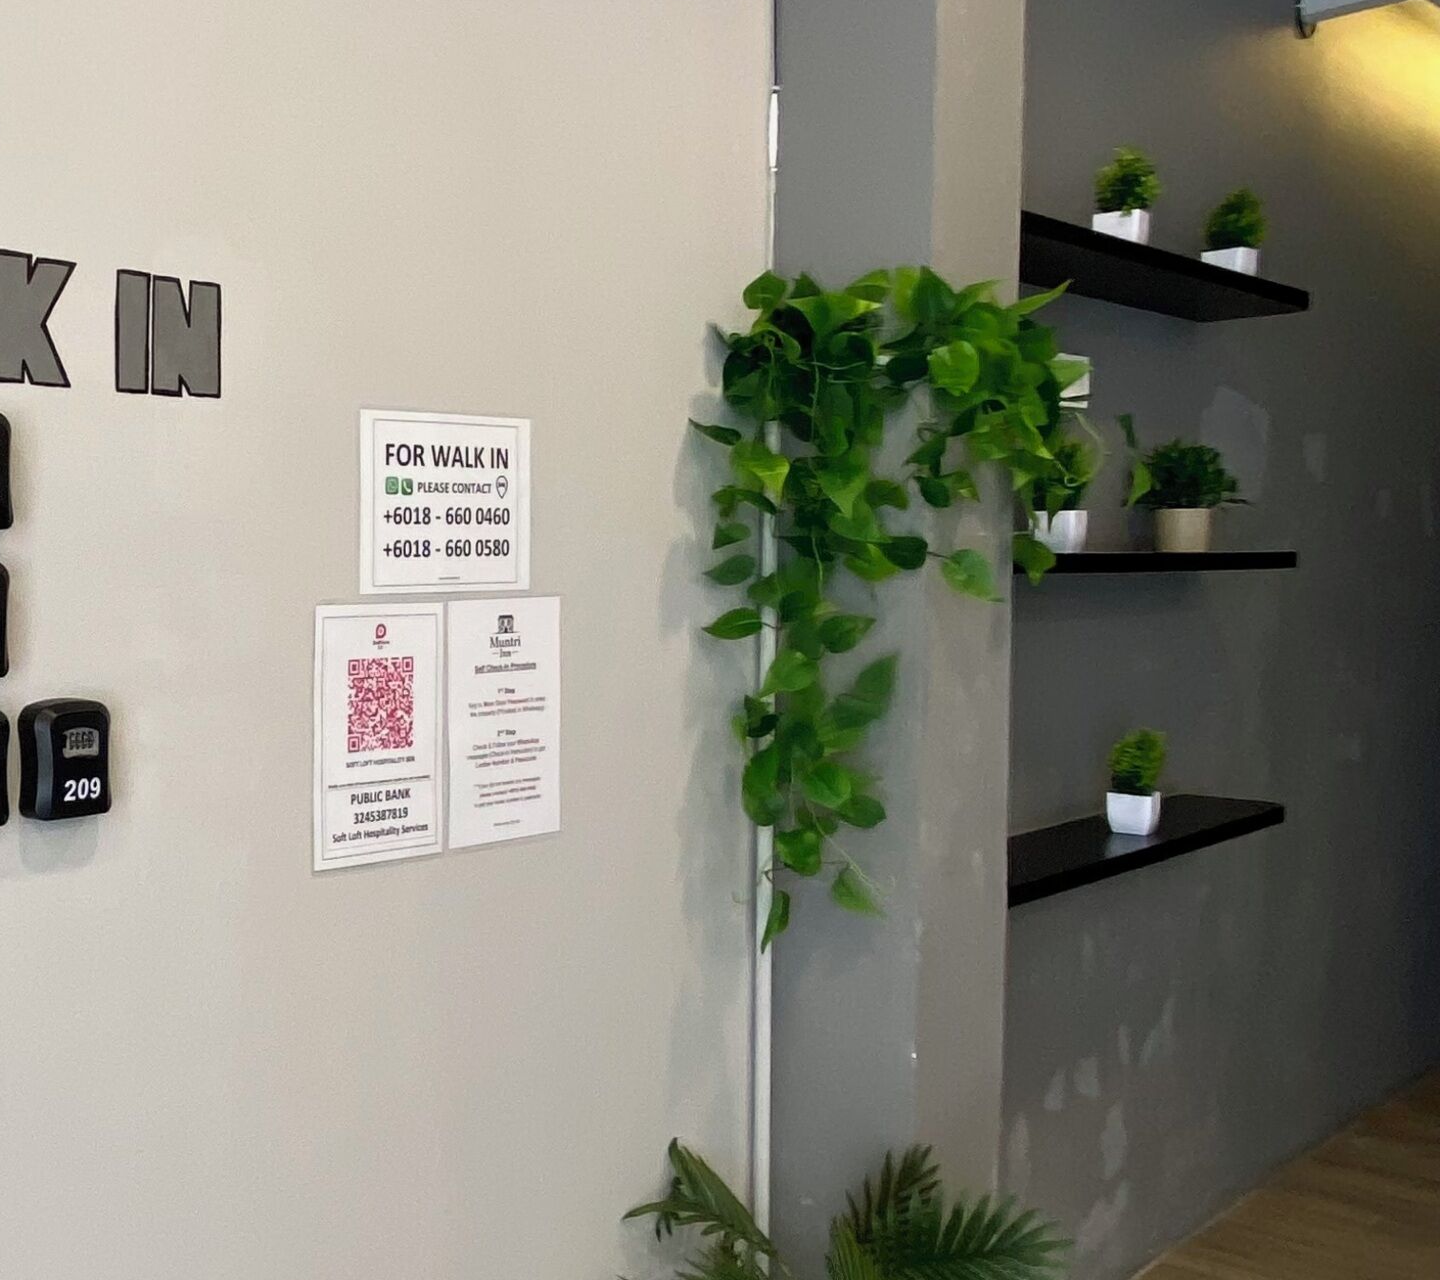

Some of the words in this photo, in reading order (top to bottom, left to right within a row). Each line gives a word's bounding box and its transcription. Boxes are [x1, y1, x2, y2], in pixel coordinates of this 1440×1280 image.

[115, 269, 222, 399] IN
[385, 443, 425, 467] FOR
[431, 445, 485, 469] WALK
[491, 447, 509, 469] IN
[417, 481, 450, 494] PLEASE
[452, 482, 492, 494] CONTACT
[384, 506, 431, 525] +6018
[445, 506, 471, 525] 660
[475, 507, 510, 525] 0460
[383, 539, 431, 558] +6018
[445, 539, 471, 558] 660
[475, 539, 510, 557] 0580
[489, 635, 521, 649] Muntri
[63, 776, 101, 802] 209
[350, 790, 383, 805] PUBLIC
[385, 788, 411, 801] BANK
[353, 806, 409, 824] 3245387819
[332, 832, 347, 843] Soft
[348, 830, 362, 841] Loft
[363, 826, 400, 839] Hospitality
[401, 824, 429, 834] Services
